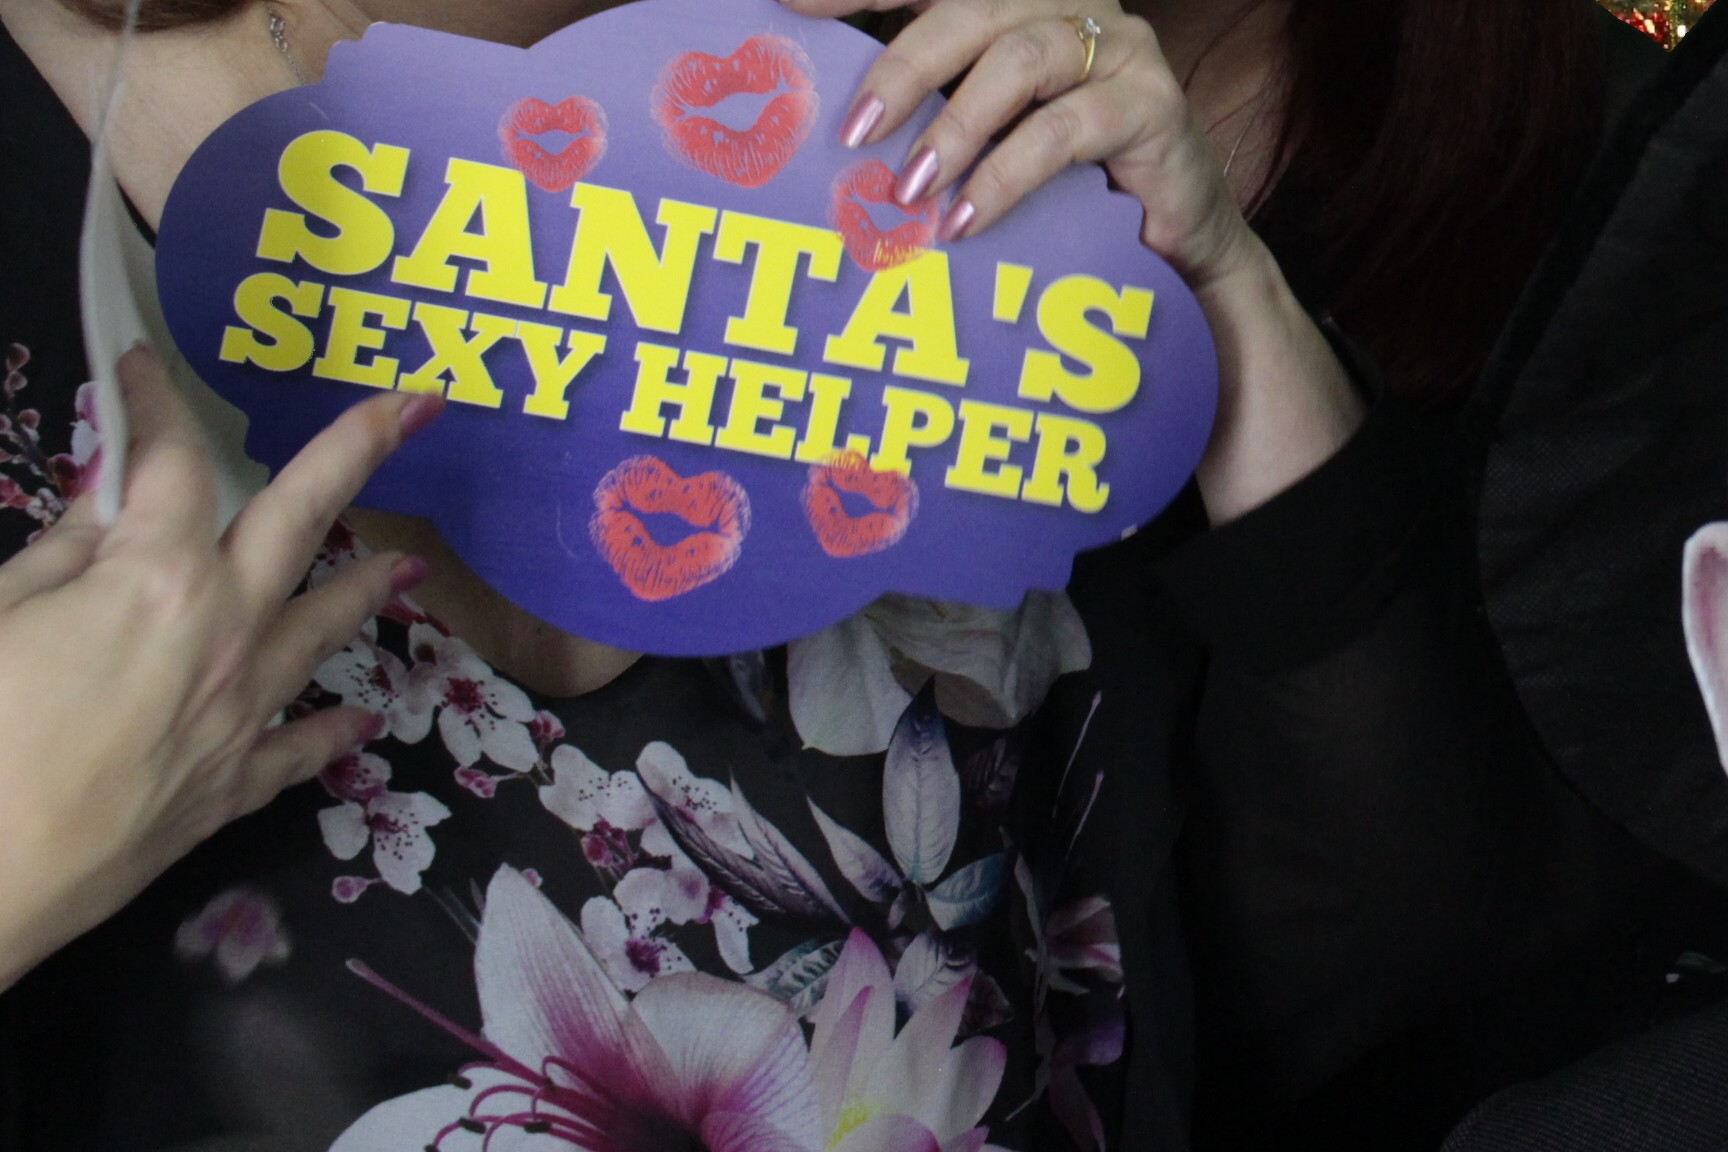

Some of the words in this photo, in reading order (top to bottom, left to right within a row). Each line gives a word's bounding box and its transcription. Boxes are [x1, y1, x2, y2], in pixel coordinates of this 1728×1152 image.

[219, 272, 606, 420] SEXY
[621, 342, 1110, 512] HELPER
[256, 130, 1154, 412] SANTA'S
